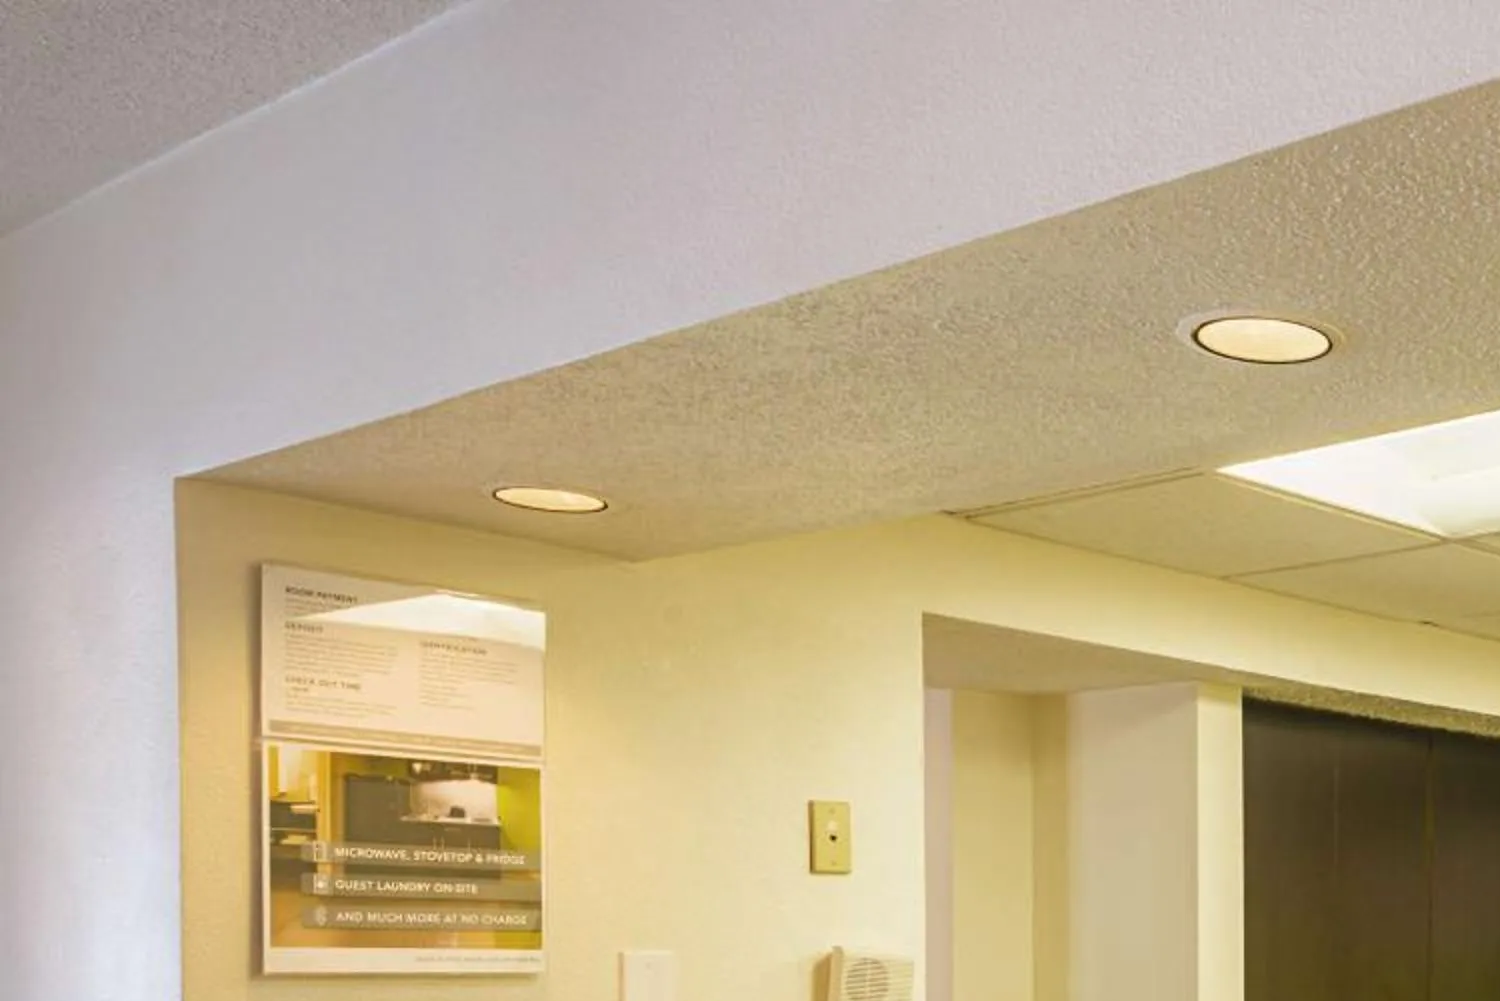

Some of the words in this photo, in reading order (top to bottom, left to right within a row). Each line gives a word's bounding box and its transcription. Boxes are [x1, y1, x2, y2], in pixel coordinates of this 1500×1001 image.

[317, 591, 358, 604] PAYMENT
[334, 848, 409, 861] MICROWAVE,
[413, 850, 473, 864] STOVETOP
[475, 853, 483, 863] &
[486, 853, 525, 865] FRIDGE
[334, 878, 373, 891] GUEST
[376, 879, 431, 893] LAUNDRY
[335, 911, 363, 924] AND
[367, 911, 402, 924] MUCH
[406, 912, 440, 925] MORE
[442, 913, 459, 924] AT
[461, 913, 480, 925] NO
[481, 913, 528, 926] CHARGE
